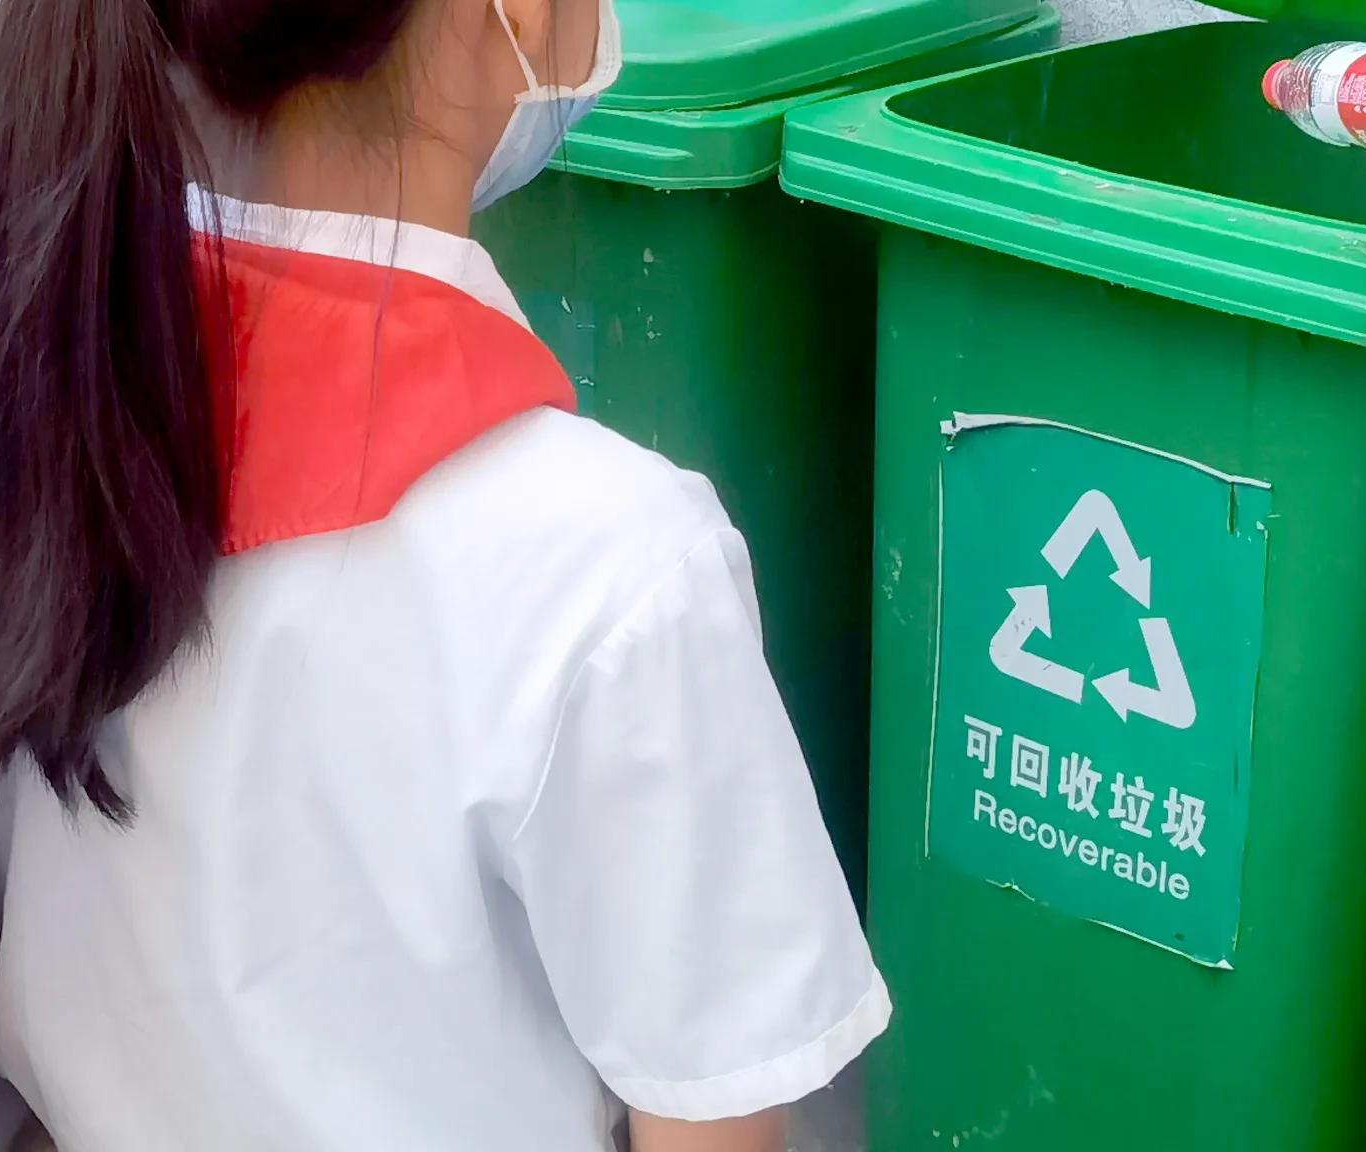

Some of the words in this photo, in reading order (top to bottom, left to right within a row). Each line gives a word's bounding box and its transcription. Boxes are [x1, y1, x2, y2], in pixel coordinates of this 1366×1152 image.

[963, 714, 1207, 857] 可回收垃圾
[973, 789, 1190, 900] Recoverable
